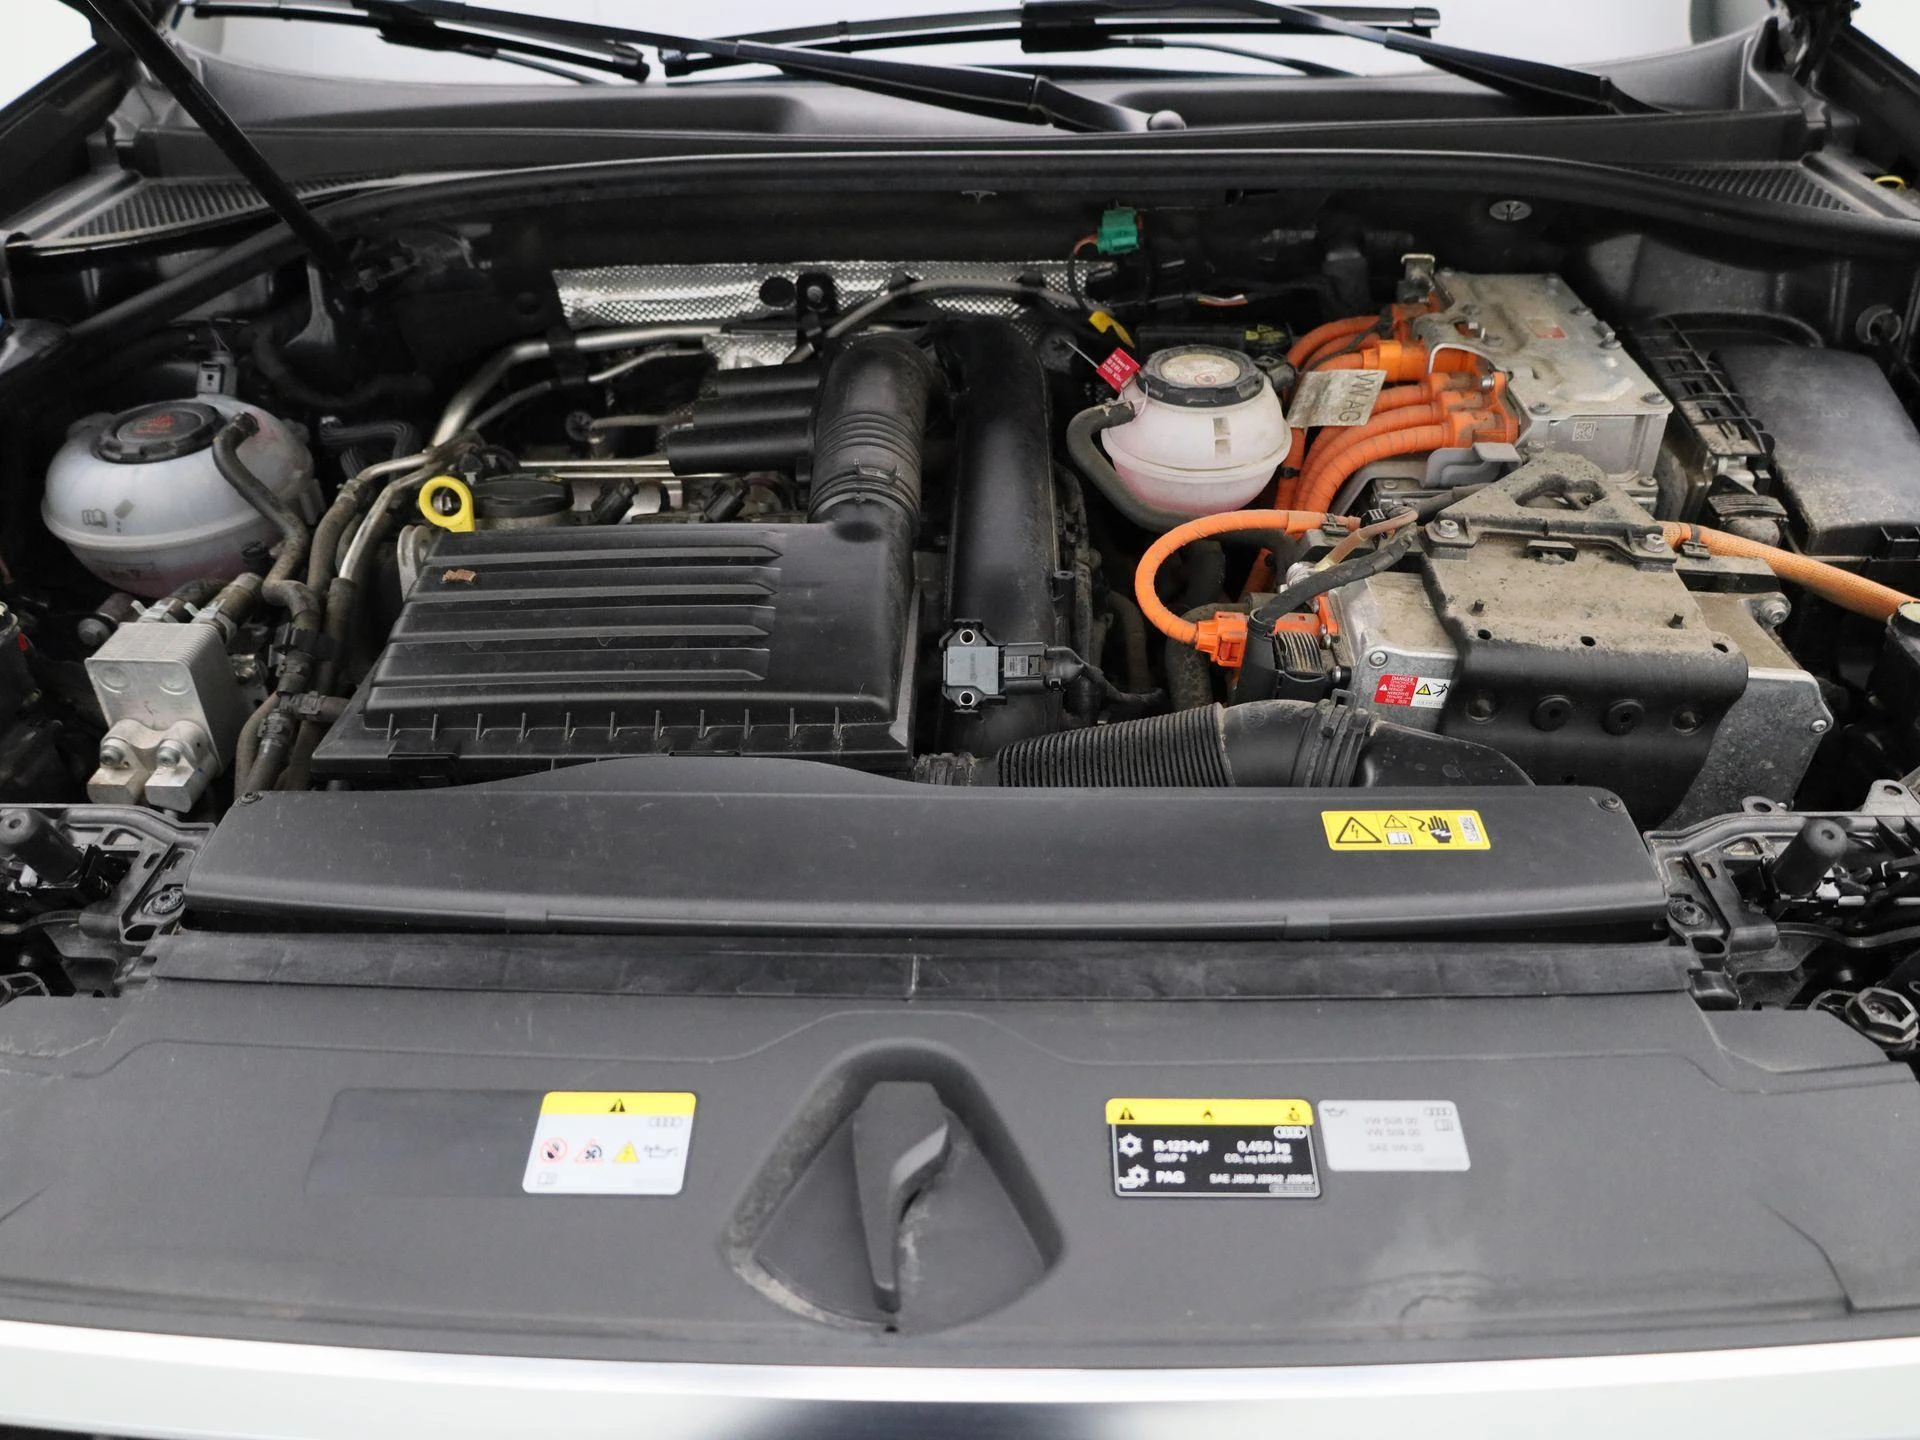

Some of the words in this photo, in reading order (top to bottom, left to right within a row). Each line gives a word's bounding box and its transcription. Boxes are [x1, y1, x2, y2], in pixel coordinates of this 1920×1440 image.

[1153, 1139, 1210, 1154] R-1234yf
[1274, 1140, 1290, 1154] kg
[1155, 1170, 1185, 1184] PAG
